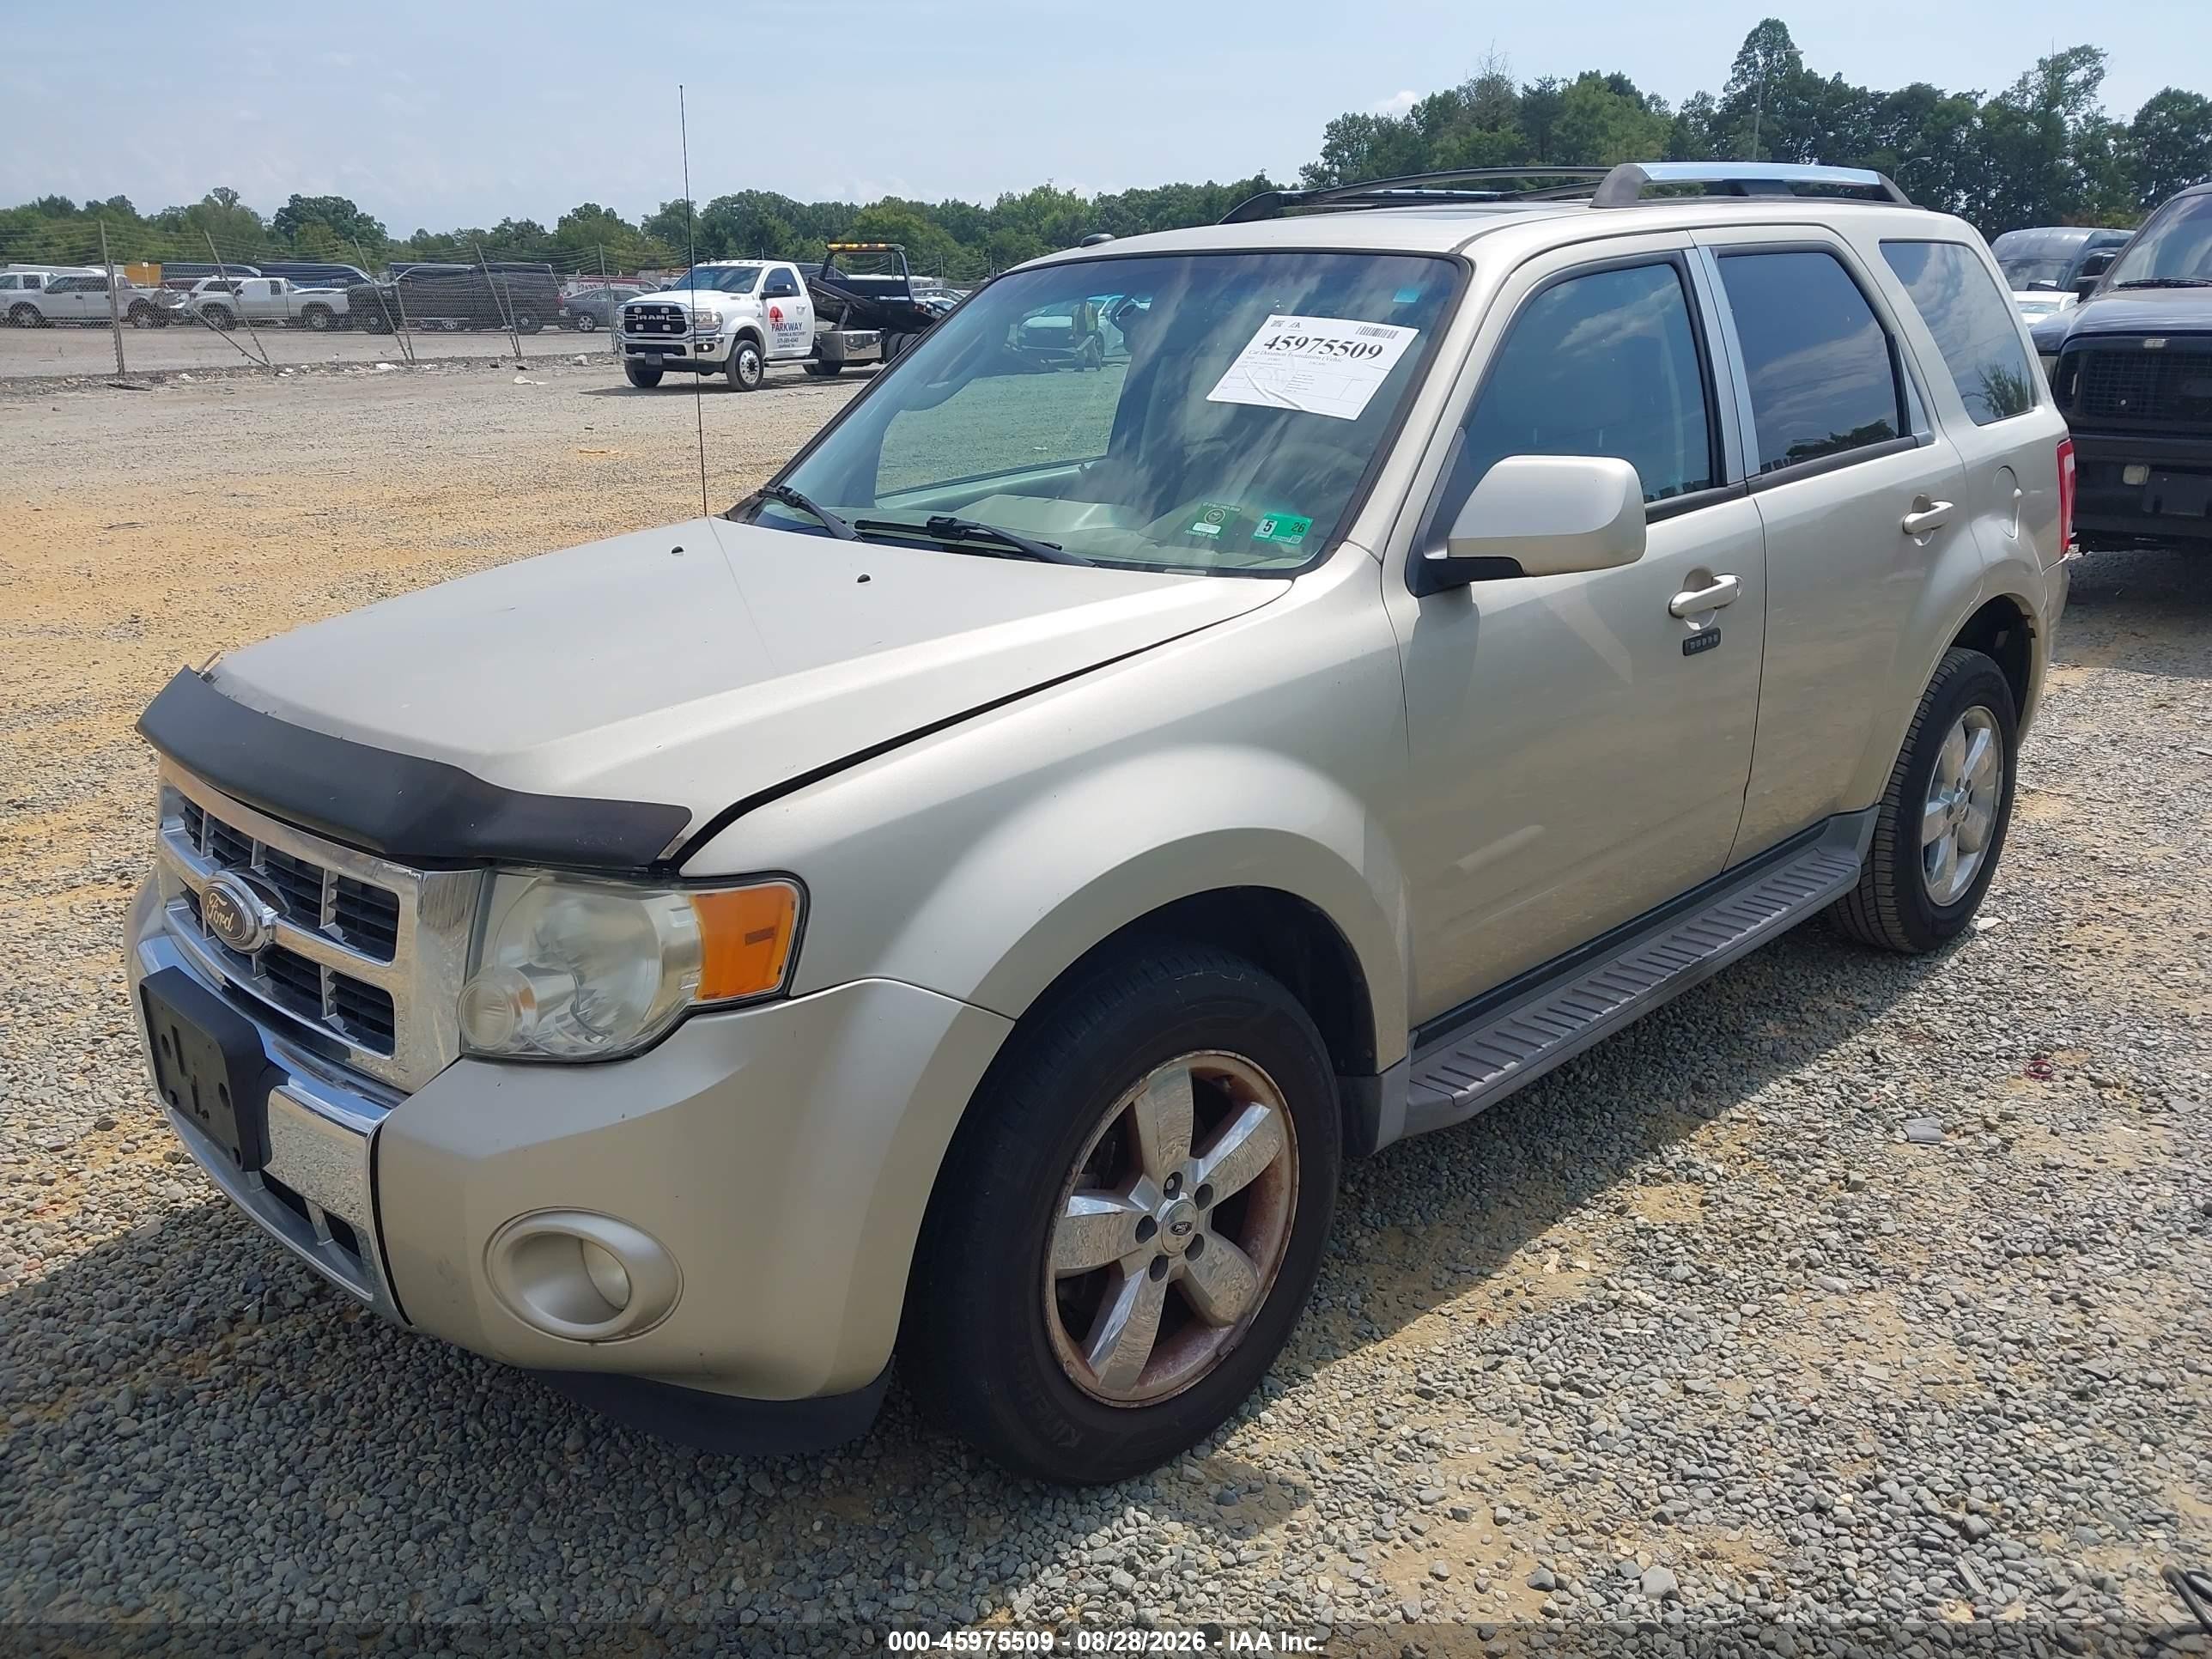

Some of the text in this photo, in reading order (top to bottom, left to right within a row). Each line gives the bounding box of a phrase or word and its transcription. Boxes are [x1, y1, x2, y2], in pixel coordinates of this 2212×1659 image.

[771, 322, 803, 332] PARKWAY
[1264, 335, 1383, 360] 45975509
[1263, 520, 1274, 532] 5
[1291, 521, 1306, 533] 26
[206, 892, 234, 933] Ford
